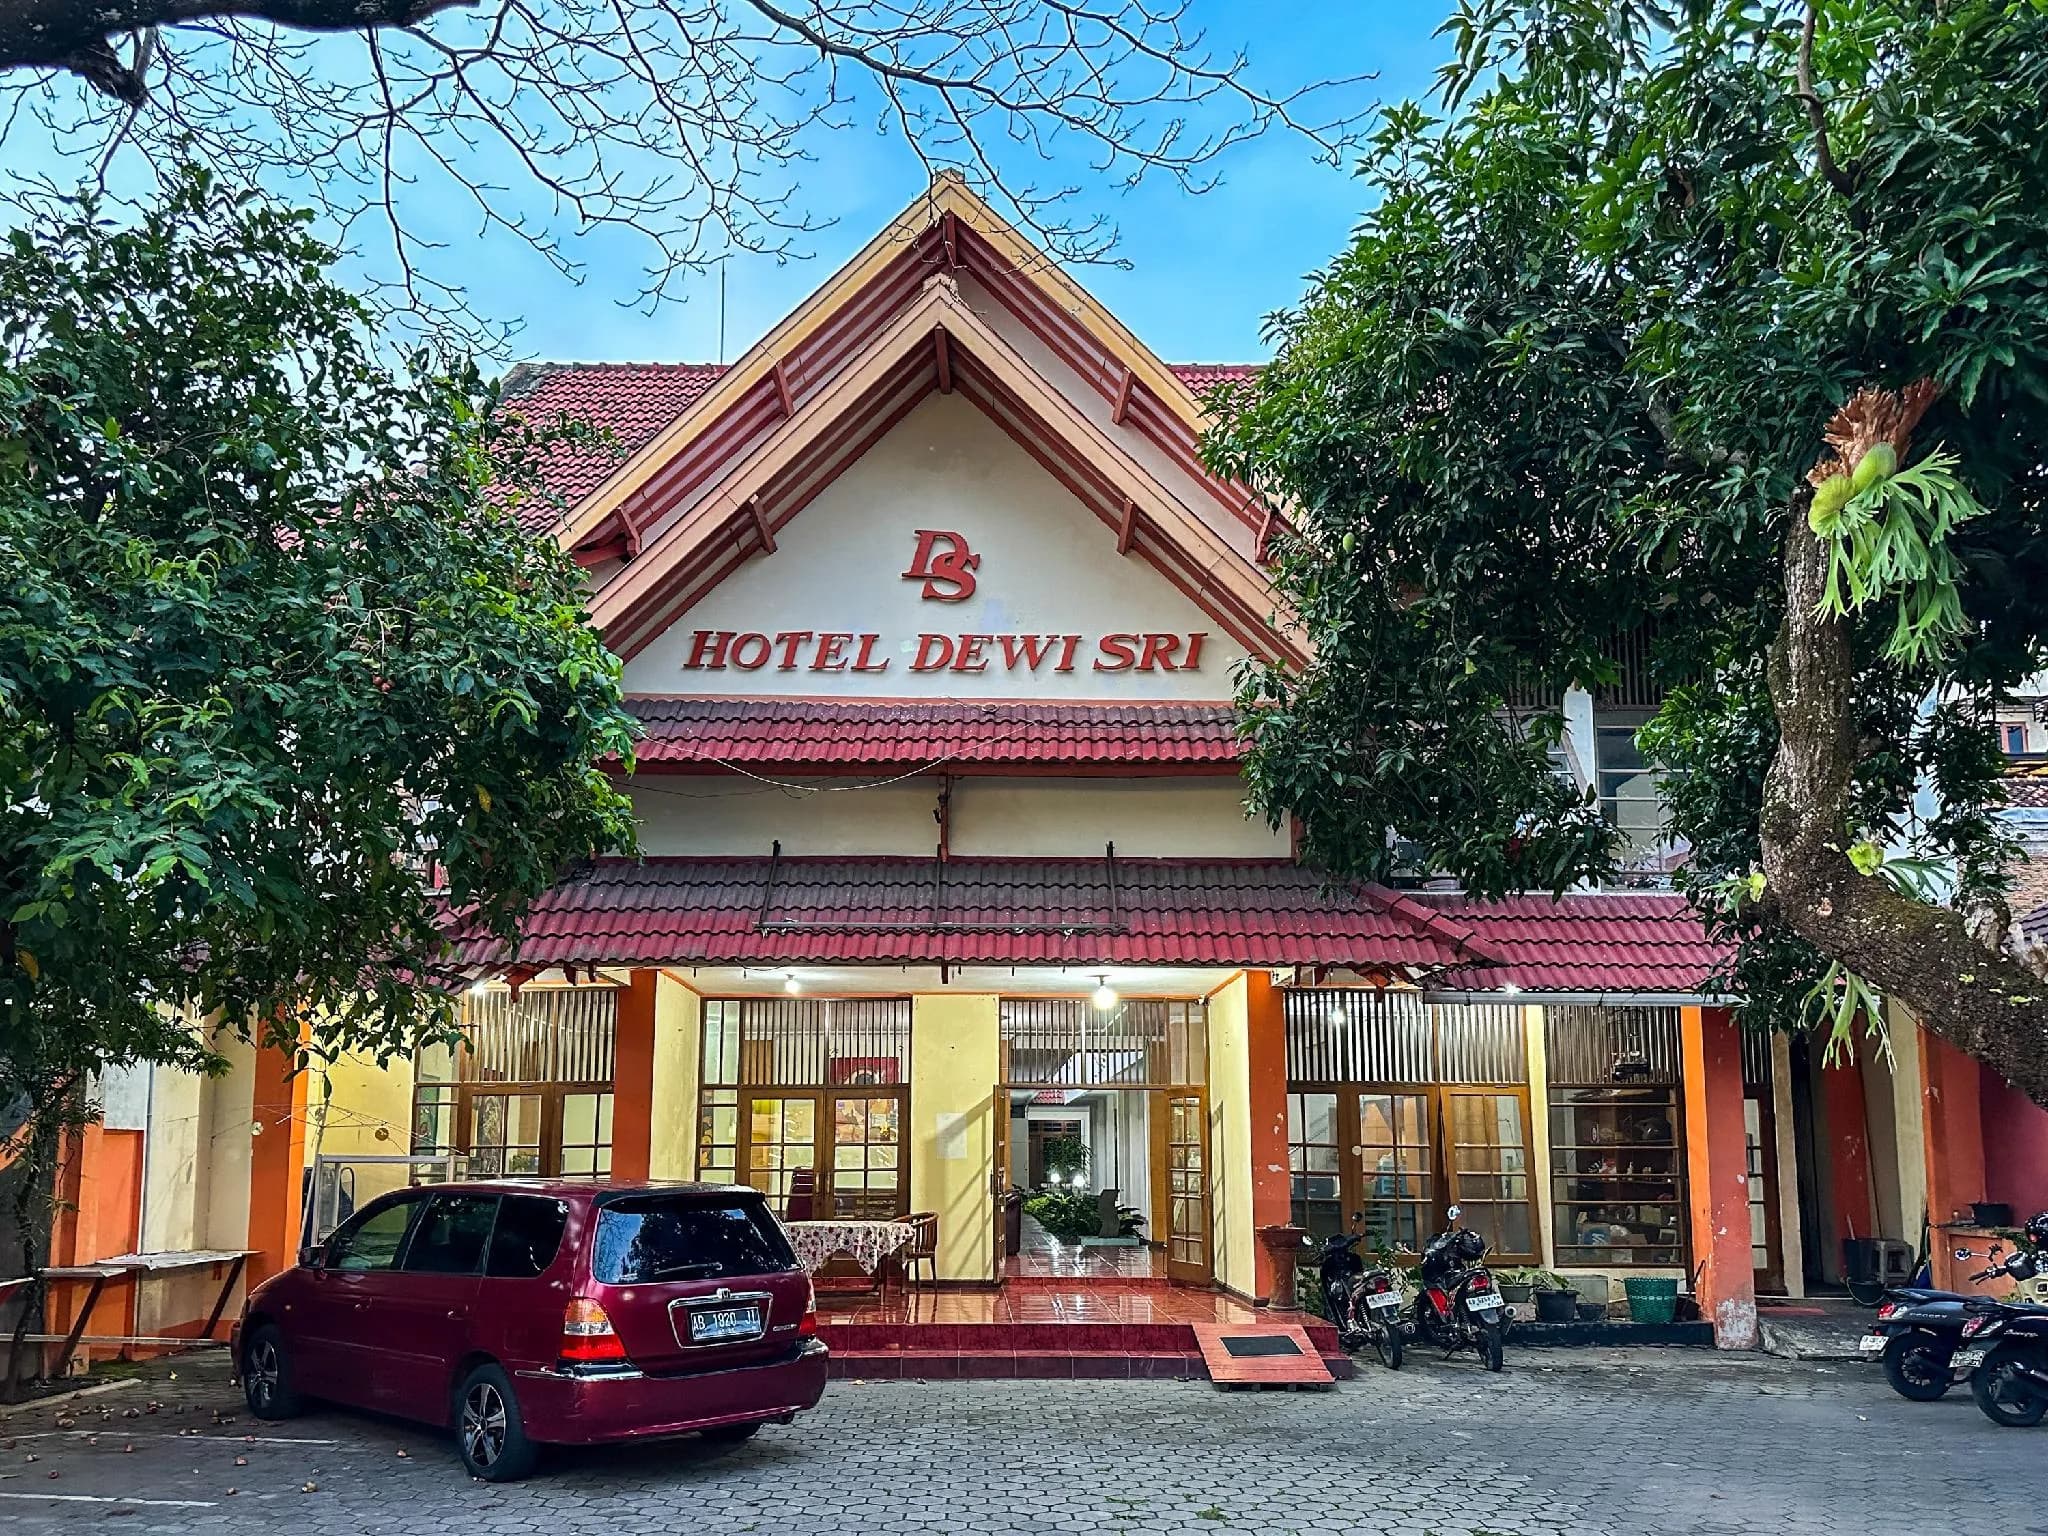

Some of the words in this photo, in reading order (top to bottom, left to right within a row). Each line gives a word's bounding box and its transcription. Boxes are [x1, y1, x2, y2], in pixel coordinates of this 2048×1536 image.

[902, 529, 980, 601] DS
[683, 629, 889, 672] HOTEL
[909, 633, 1082, 672] DEWI
[1093, 632, 1209, 672] SRI
[693, 1314, 706, 1331] AB
